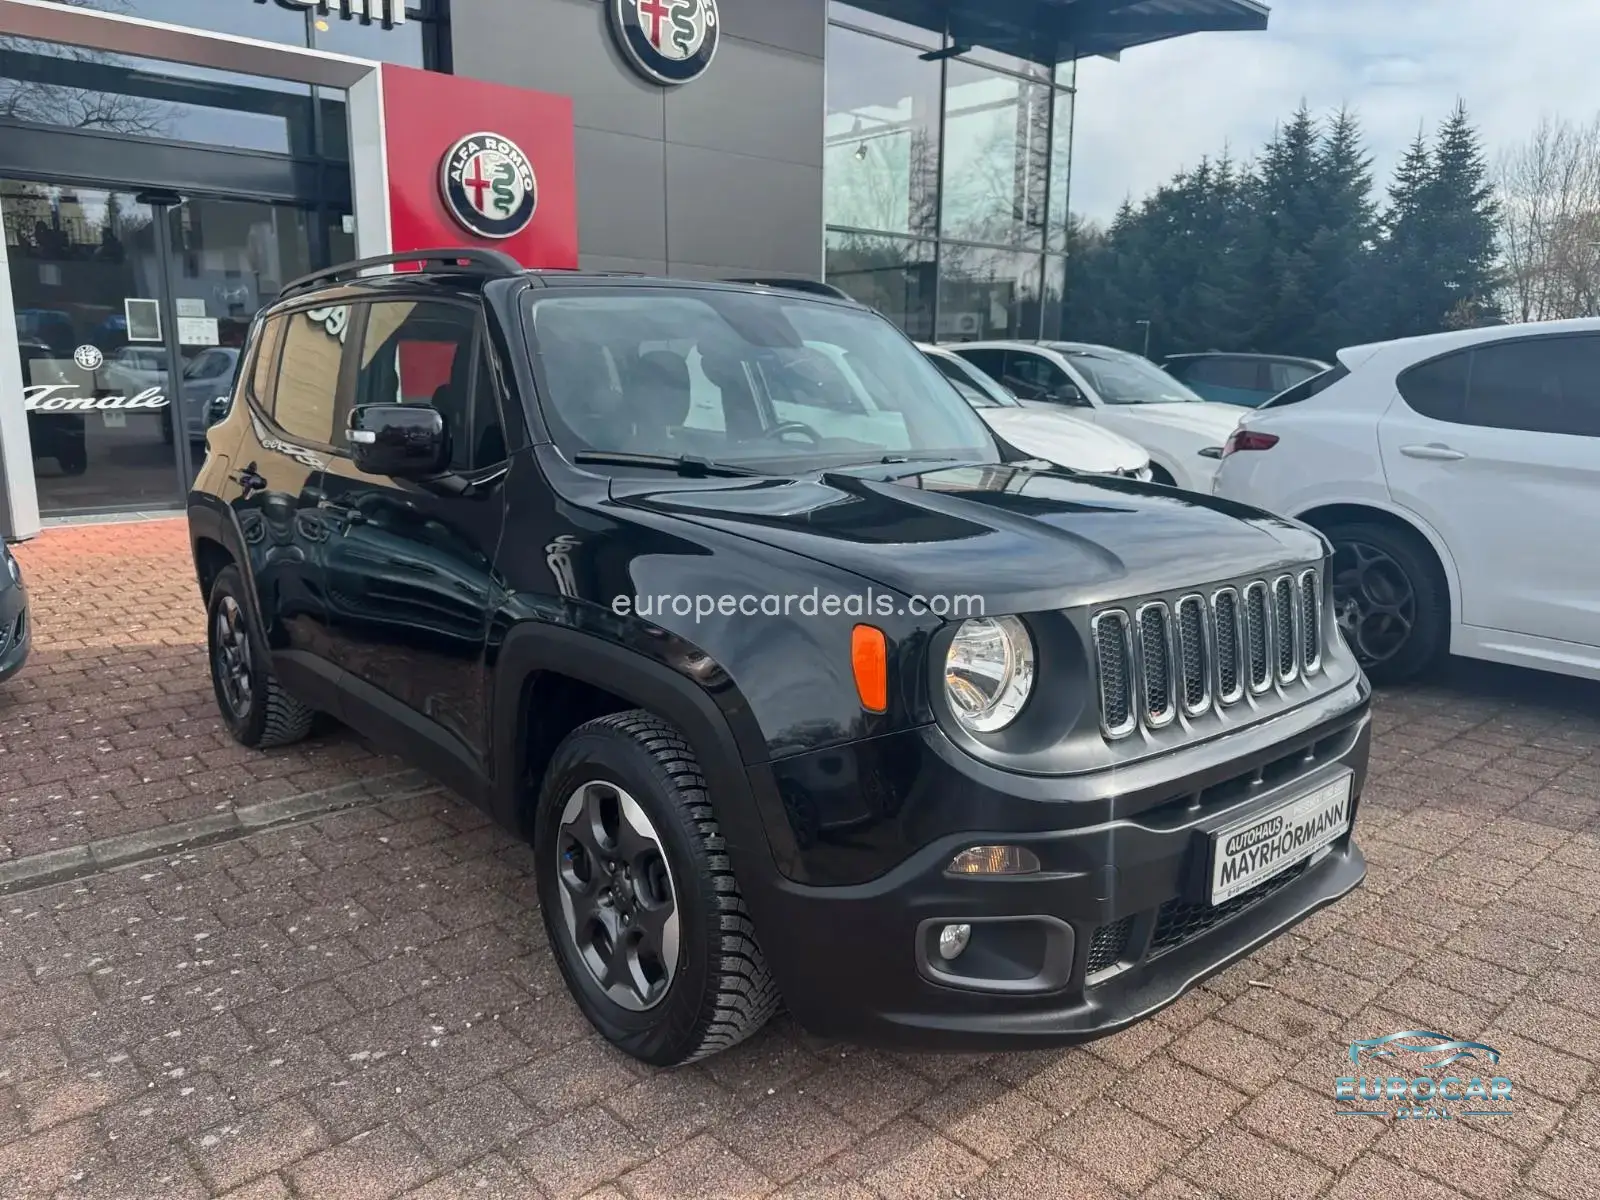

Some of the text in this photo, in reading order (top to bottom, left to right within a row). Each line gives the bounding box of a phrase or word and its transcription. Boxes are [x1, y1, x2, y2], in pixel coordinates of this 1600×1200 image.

[451, 138, 533, 191] ALFA ROMEO
[23, 384, 171, 411] Tonale
[1220, 801, 1344, 887] MAYRHÖRMANN
[1228, 817, 1282, 853] AUTOHAUS
